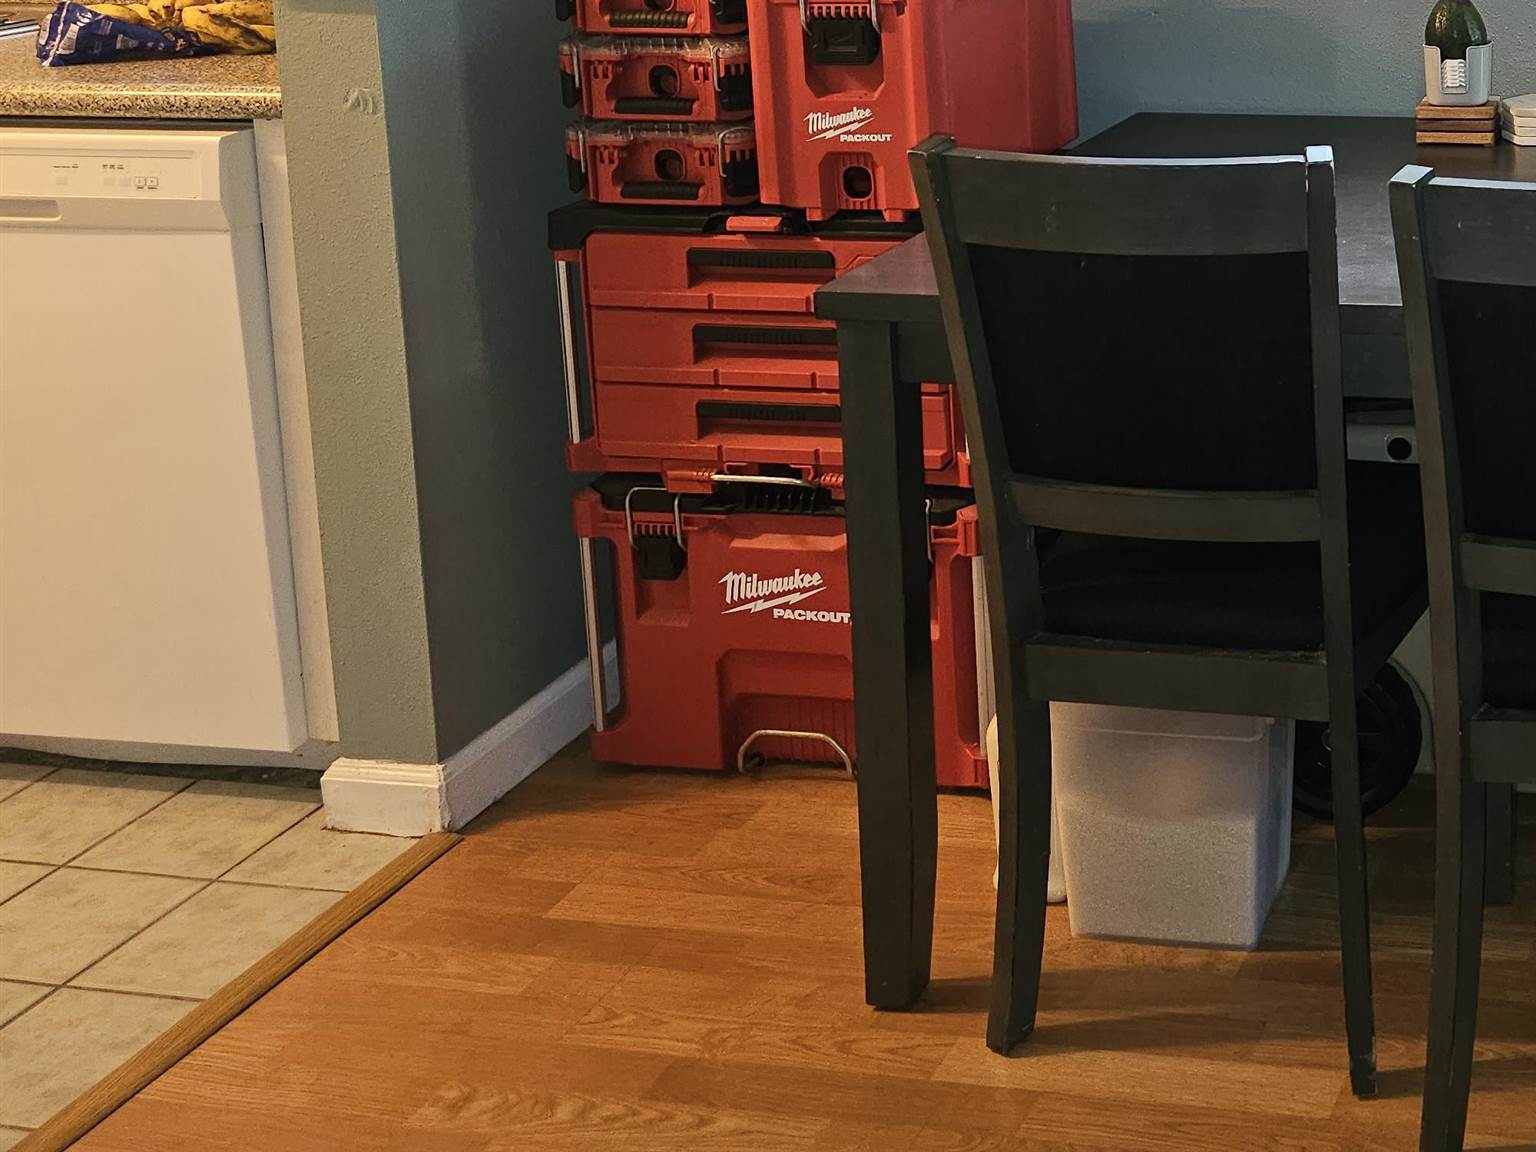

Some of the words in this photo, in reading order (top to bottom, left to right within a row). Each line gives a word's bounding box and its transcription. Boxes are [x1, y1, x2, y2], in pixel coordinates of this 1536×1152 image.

[803, 106, 873, 135] Milwaukee
[839, 134, 892, 142] PACKOUT
[718, 568, 824, 604] Milwaukee
[773, 608, 851, 624] PACKOUT
